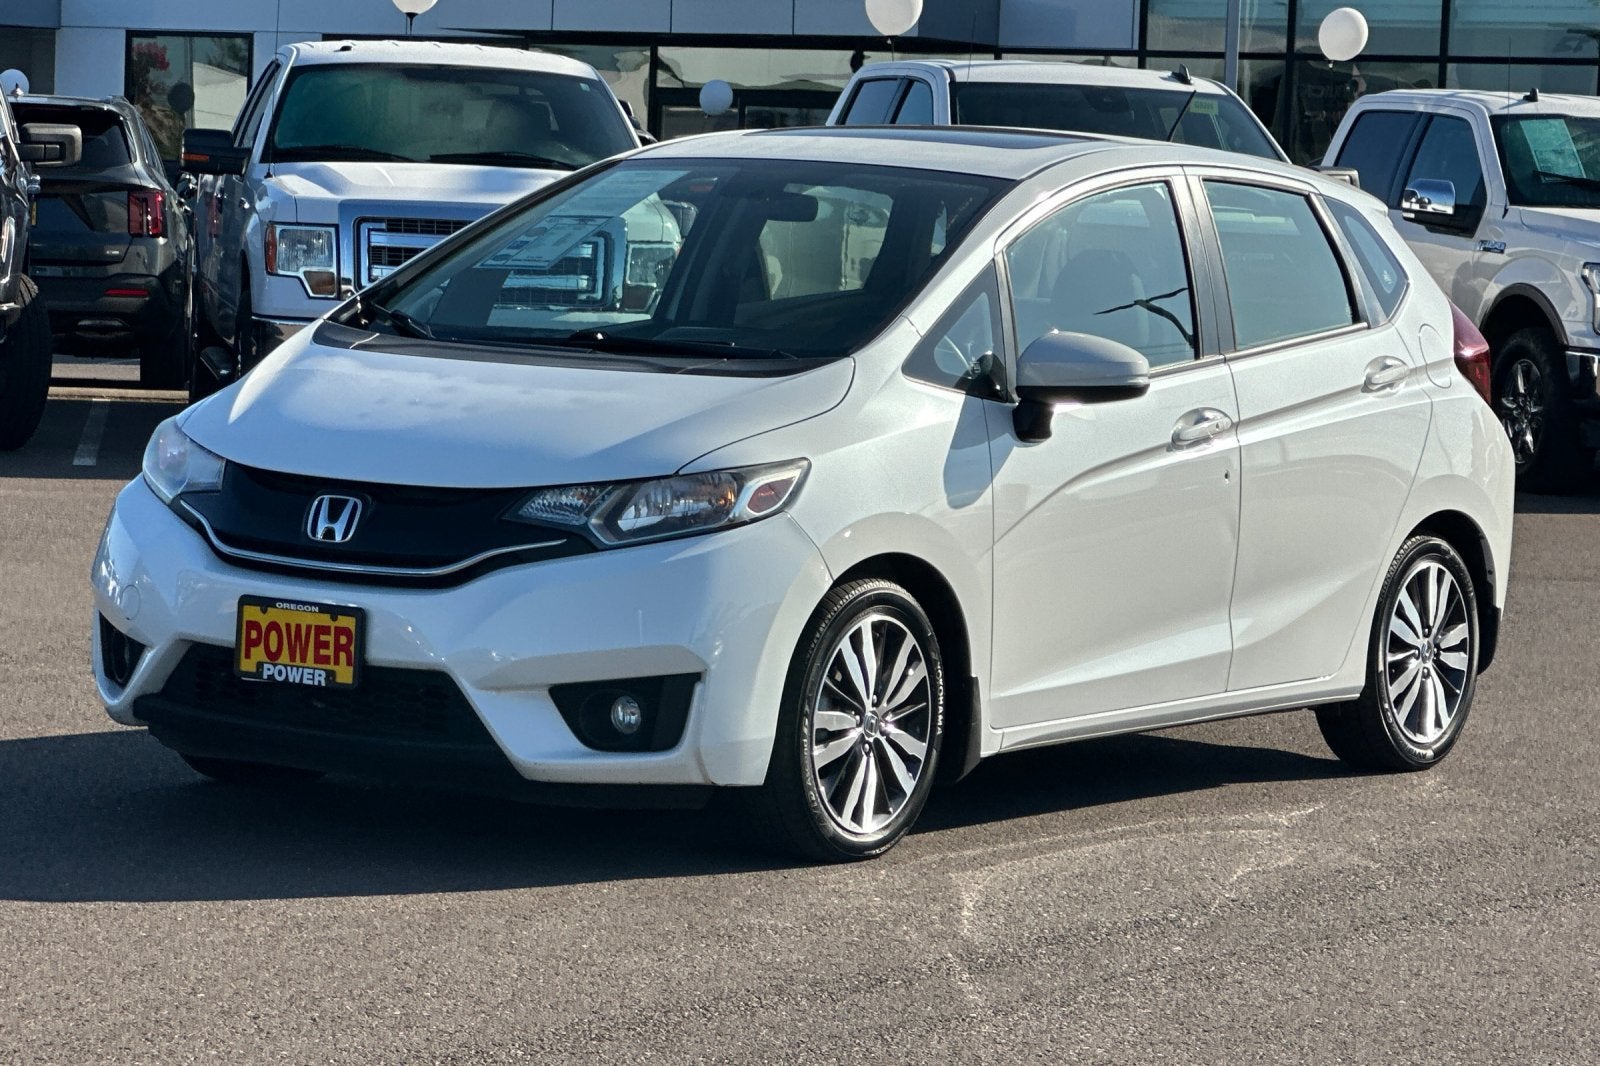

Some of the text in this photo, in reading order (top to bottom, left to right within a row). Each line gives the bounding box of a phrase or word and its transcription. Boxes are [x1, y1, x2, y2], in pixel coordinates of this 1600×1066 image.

[275, 602, 320, 613] OREGON
[244, 619, 354, 667] POWER
[262, 663, 327, 687] POWER
